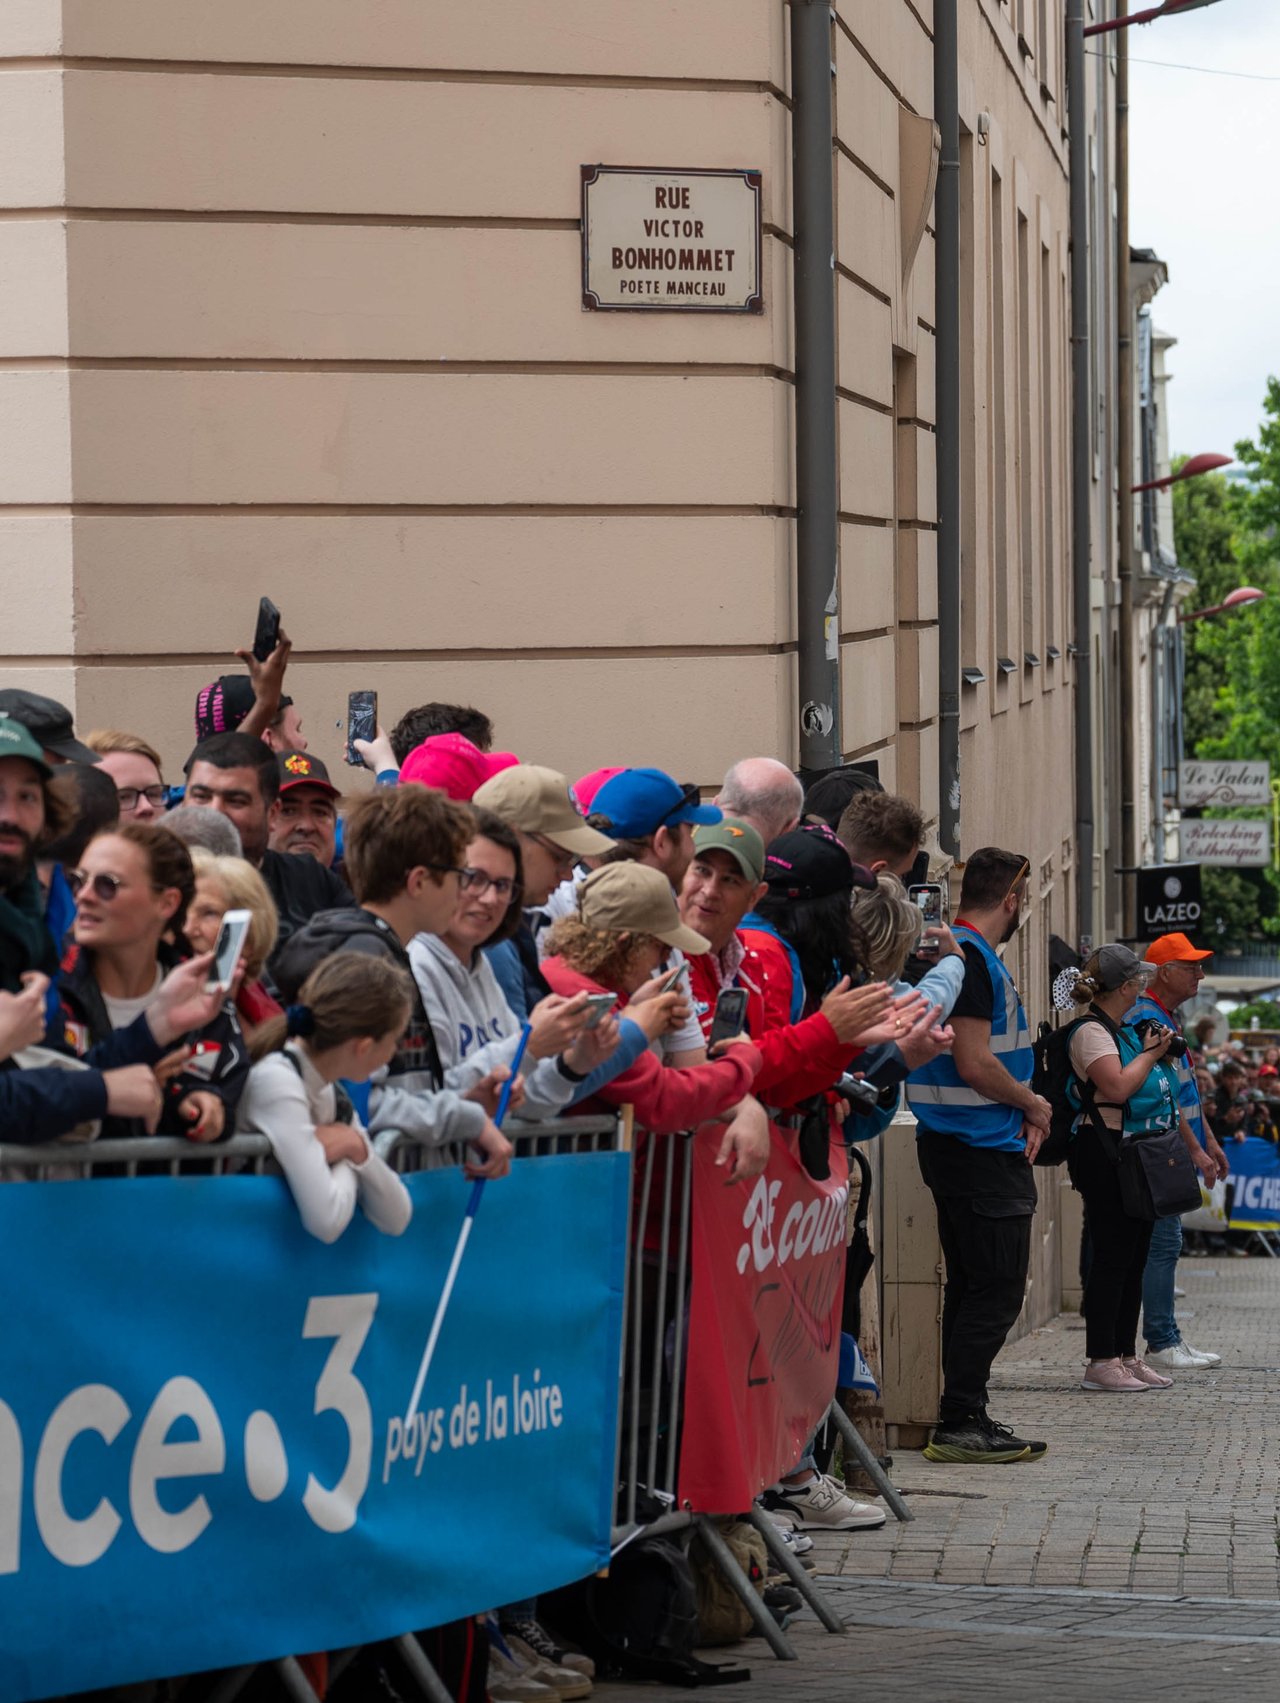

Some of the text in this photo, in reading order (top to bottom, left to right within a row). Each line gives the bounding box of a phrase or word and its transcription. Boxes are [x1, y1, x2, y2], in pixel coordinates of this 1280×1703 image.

[655, 187, 690, 209] RUE
[643, 219, 704, 238] VICTOR
[612, 247, 735, 271] BONHOMMET
[620, 280, 726, 296] POETE MANCEAU
[1209, 764, 1265, 786] Salon
[1144, 902, 1201, 923] LAZEO
[383, 1368, 564, 1484] pays de la loire
